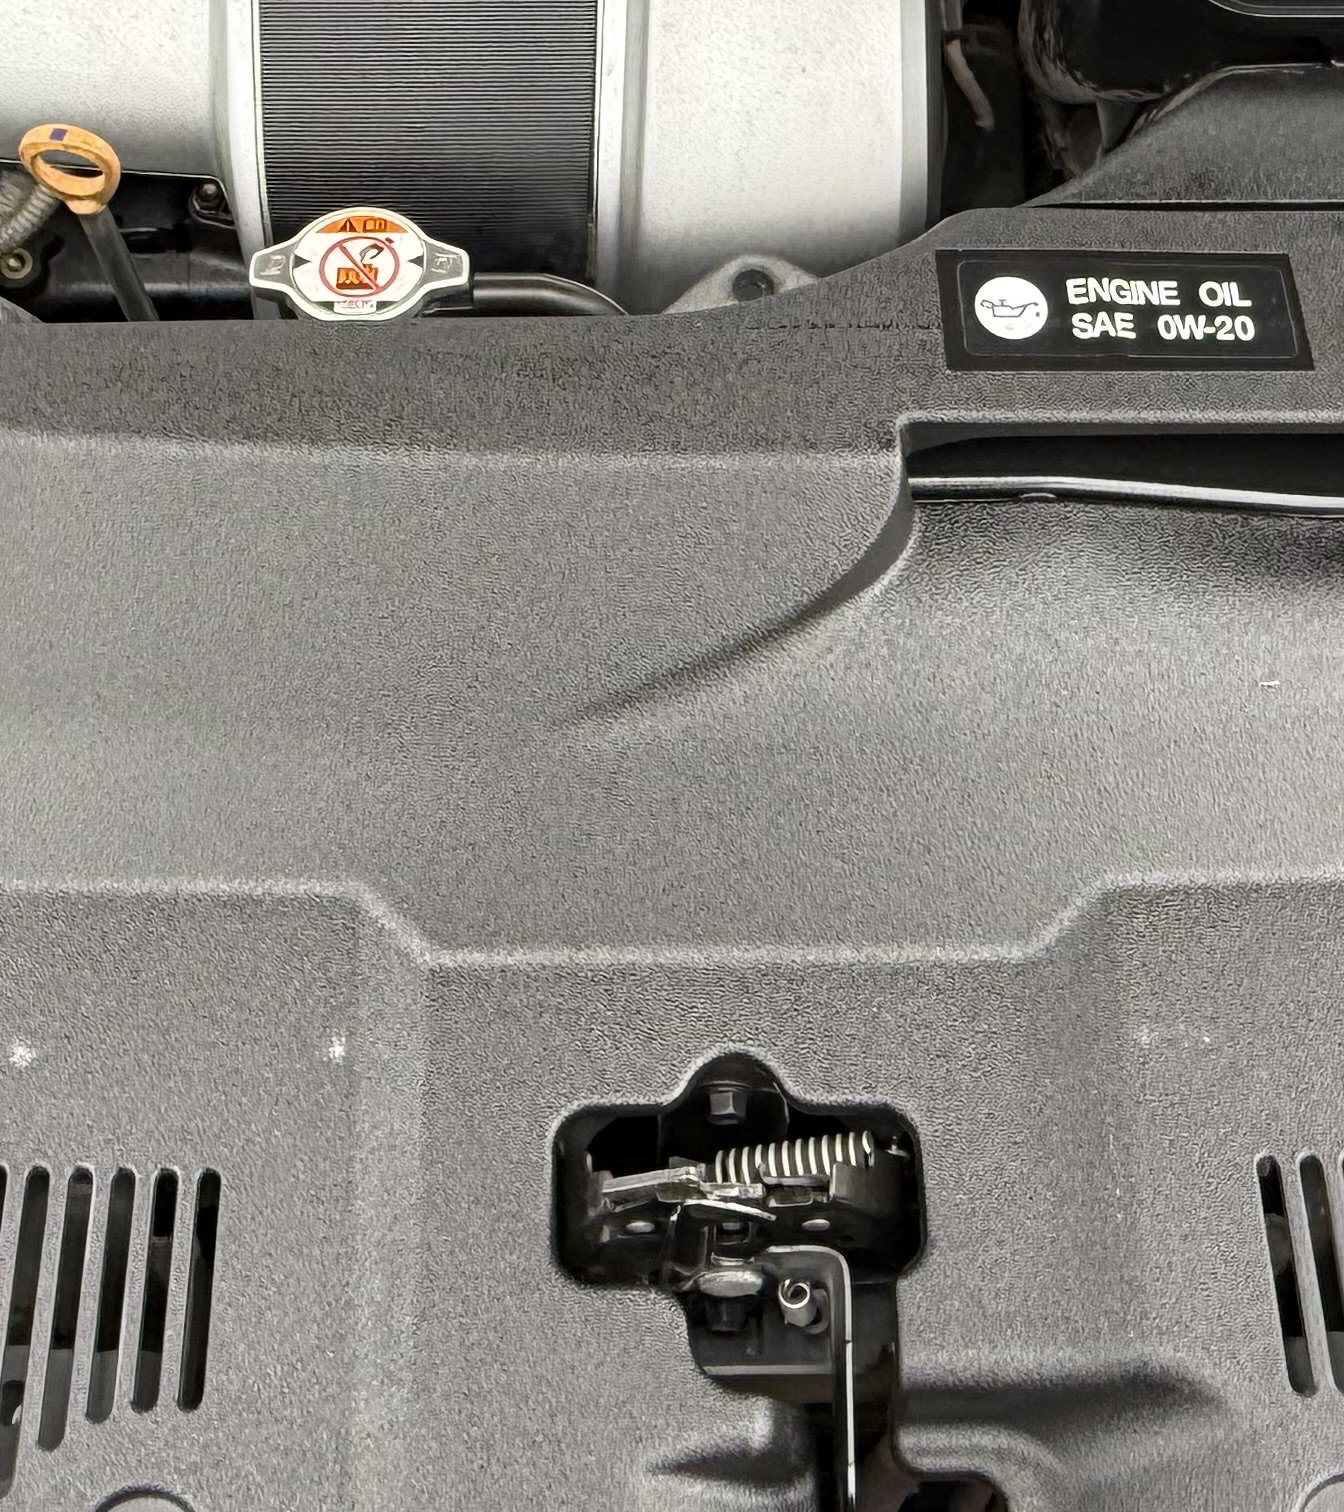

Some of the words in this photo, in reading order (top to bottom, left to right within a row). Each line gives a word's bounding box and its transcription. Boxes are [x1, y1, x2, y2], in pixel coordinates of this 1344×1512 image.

[1065, 276, 1181, 306] ENGINE
[1198, 280, 1253, 308] OIL
[1071, 311, 1137, 341] SAE
[1157, 314, 1256, 341] 0W-20
